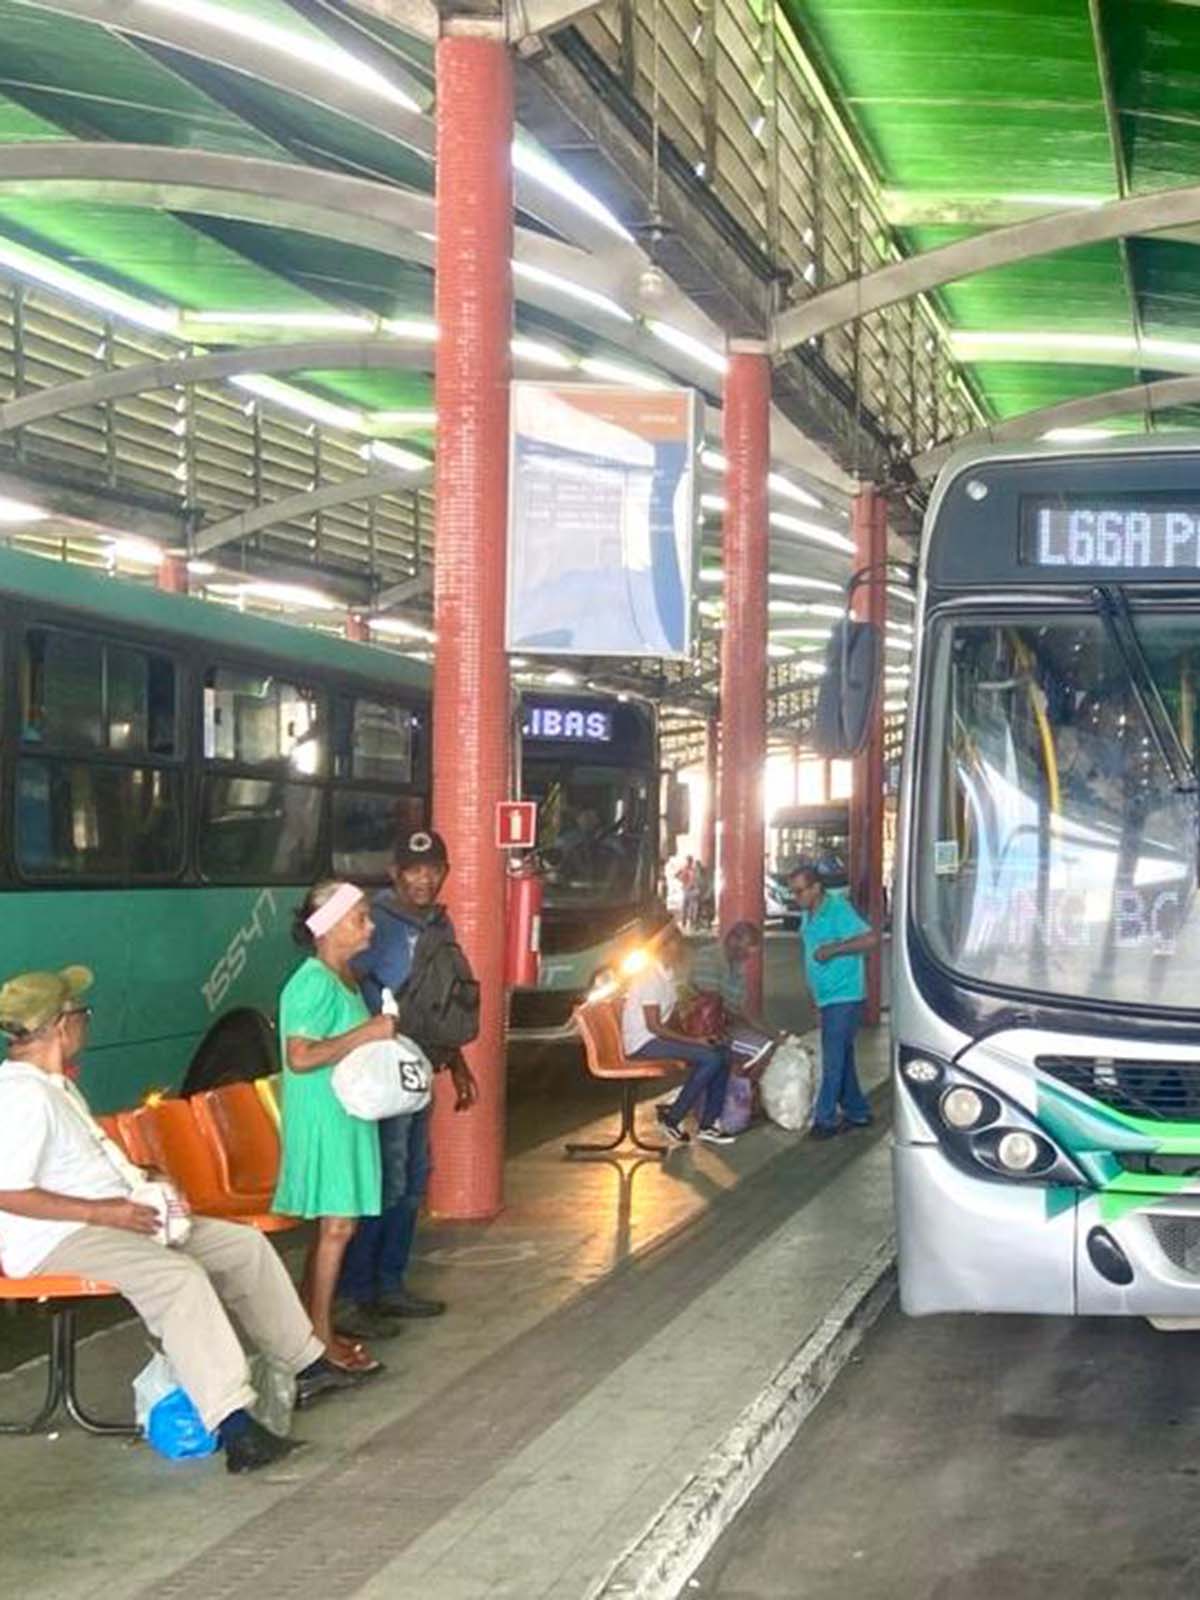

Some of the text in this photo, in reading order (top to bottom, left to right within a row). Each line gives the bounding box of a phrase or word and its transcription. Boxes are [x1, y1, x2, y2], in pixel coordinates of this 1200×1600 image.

[1039, 508, 1151, 567] L66A
[522, 708, 608, 737] IBAS
[201, 888, 278, 1013] 15547
